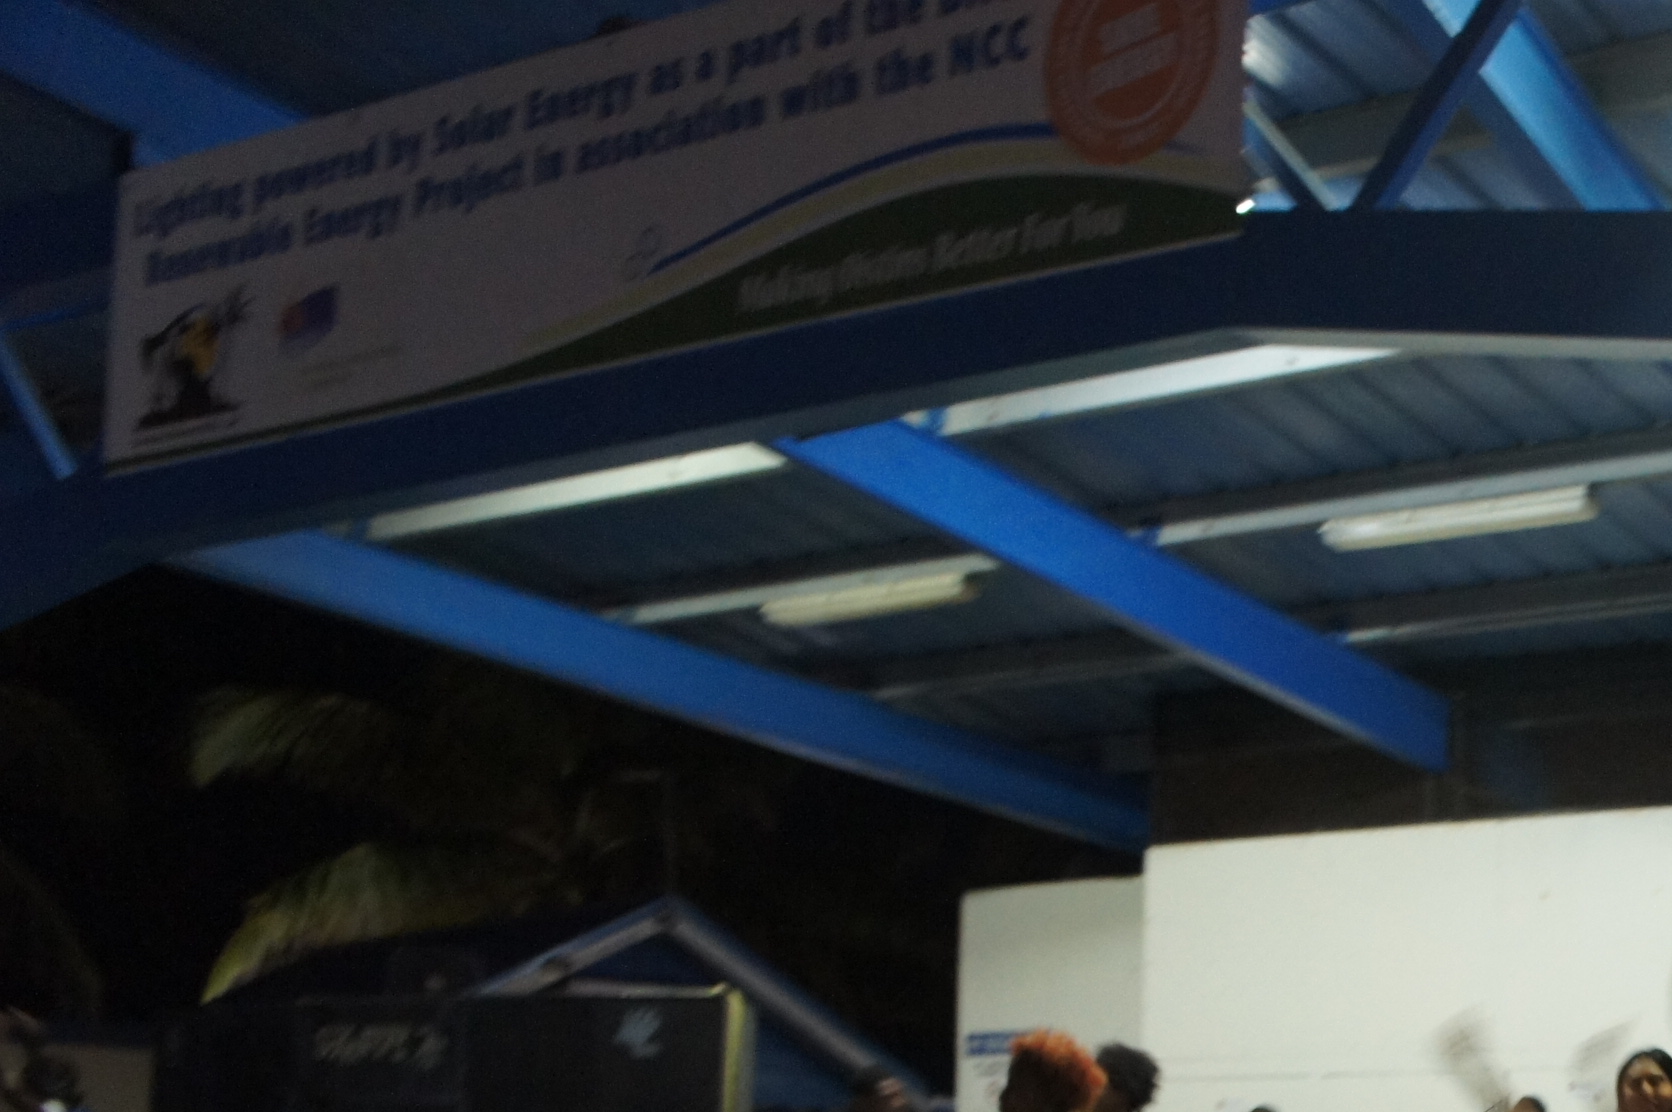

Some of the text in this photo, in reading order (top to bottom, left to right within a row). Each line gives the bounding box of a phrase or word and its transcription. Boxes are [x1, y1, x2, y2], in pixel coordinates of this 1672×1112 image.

[134, 178, 246, 238] Lighting
[251, 135, 379, 212] powered
[385, 130, 424, 173] by
[432, 105, 514, 158] Solar
[524, 74, 637, 129] Energy
[648, 56, 685, 97] as
[694, 49, 716, 82] a
[727, 17, 802, 86] part
[815, 0, 851, 48] of
[146, 216, 292, 285] Renewable
[302, 195, 403, 246] Energy
[411, 165, 526, 217] Project
[532, 145, 565, 187] in
[576, 98, 766, 173] association
[780, 63, 860, 119] with
[875, 44, 934, 96] the
[949, 17, 1030, 78] NCC
[739, 264, 833, 311] Making
[931, 228, 1018, 274] Better
